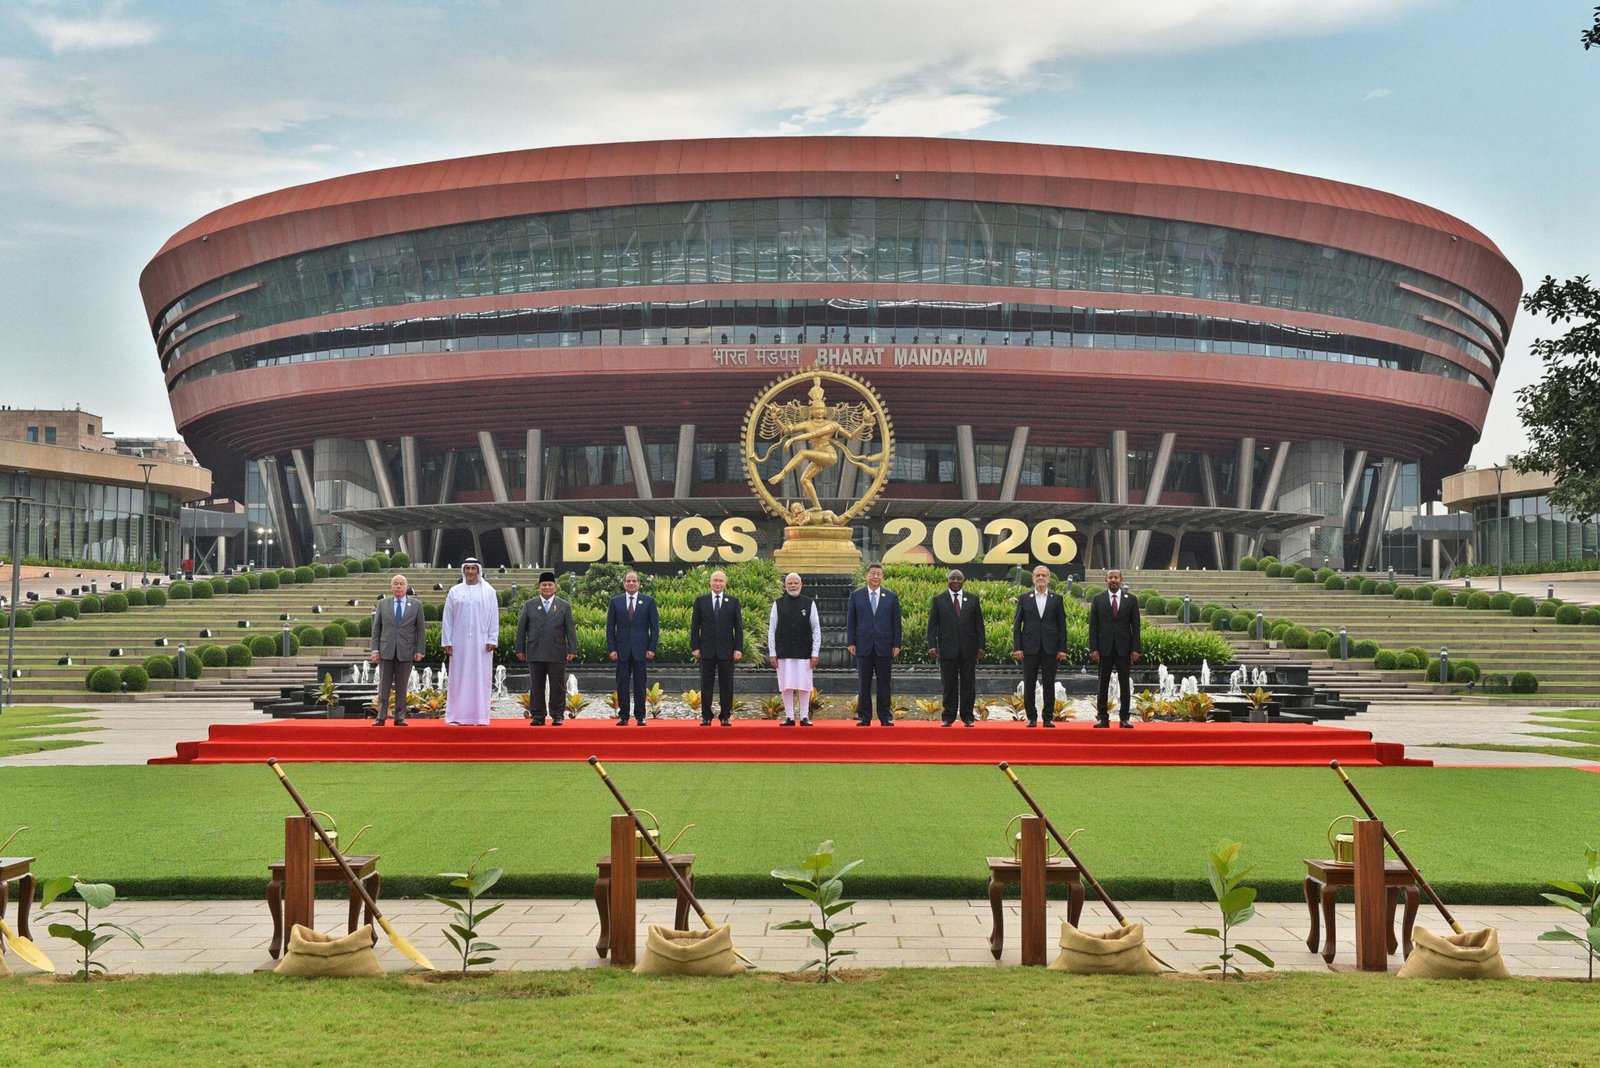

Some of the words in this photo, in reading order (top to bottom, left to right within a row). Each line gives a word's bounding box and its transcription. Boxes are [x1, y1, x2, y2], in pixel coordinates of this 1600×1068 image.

[712, 348, 748, 366] भारत
[817, 348, 884, 366] BHARAT
[894, 348, 987, 366] MANDAPAM
[562, 516, 758, 563] BRICS
[882, 518, 1078, 565] 2026
